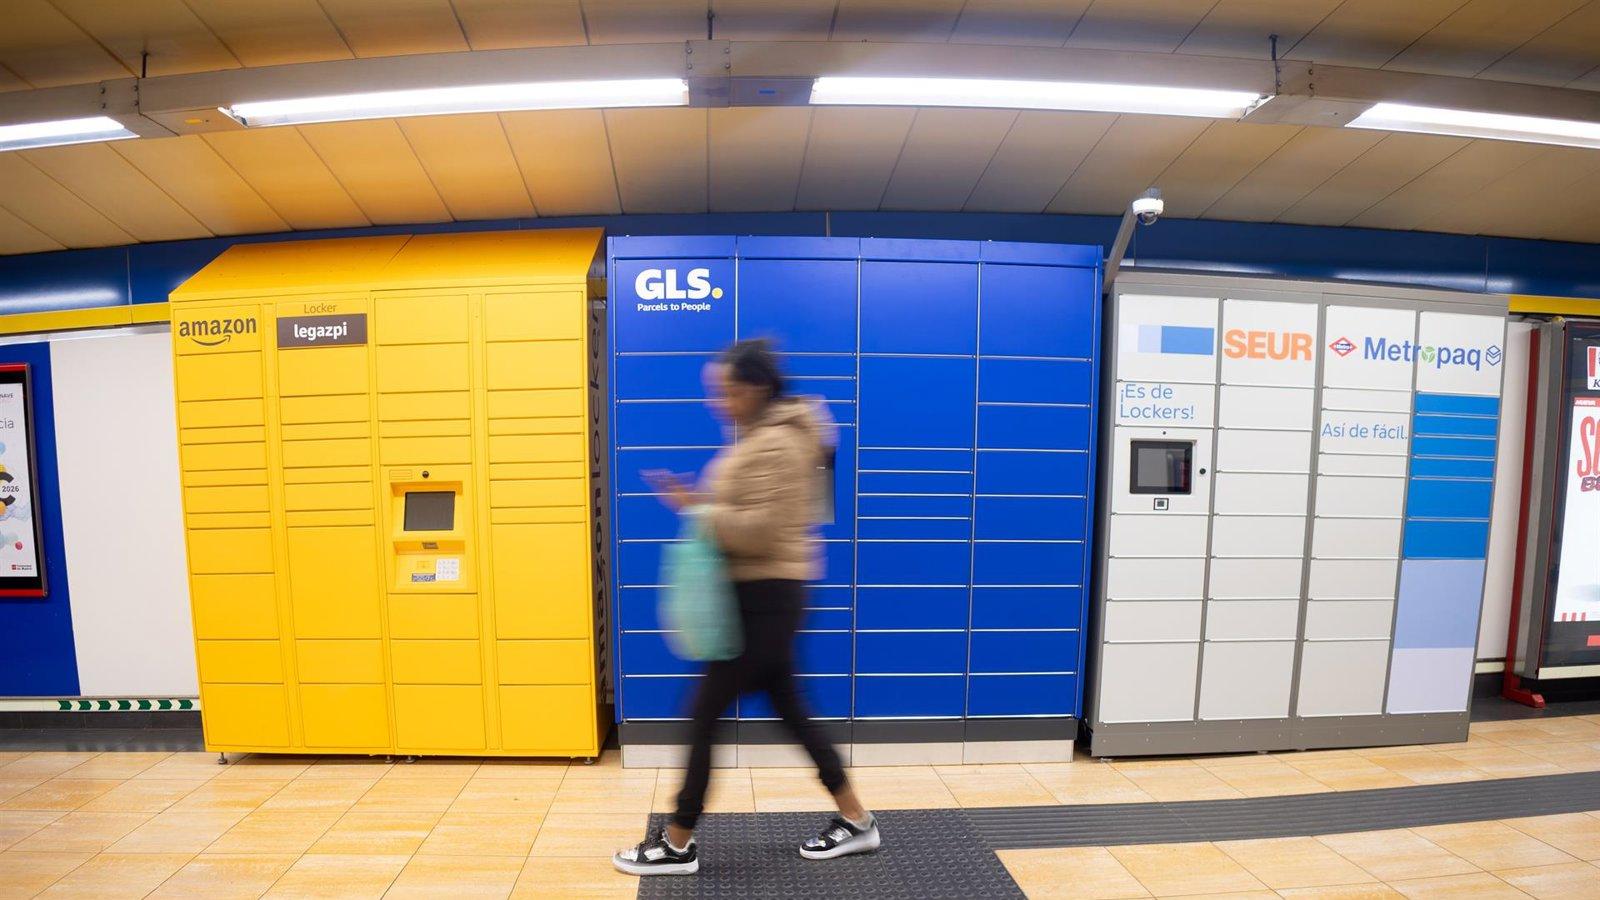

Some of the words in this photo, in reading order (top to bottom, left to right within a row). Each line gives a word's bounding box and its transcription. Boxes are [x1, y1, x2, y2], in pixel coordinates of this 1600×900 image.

[303, 302, 337, 314] Locker
[637, 303, 668, 311] Parcels
[681, 303, 711, 312] People
[179, 317, 257, 337] amazon
[293, 321, 347, 341] legazpi
[1223, 328, 1313, 361] SEUR
[1364, 336, 1481, 371] Metropaq
[1120, 383, 1145, 403] ¡Es
[1150, 383, 1174, 399] de
[1120, 403, 1194, 420] Lockers!
[1321, 422, 1346, 438] Así
[1349, 424, 1369, 438] de
[1373, 424, 1408, 440] fácil.
[2, 485, 20, 493] 2026
